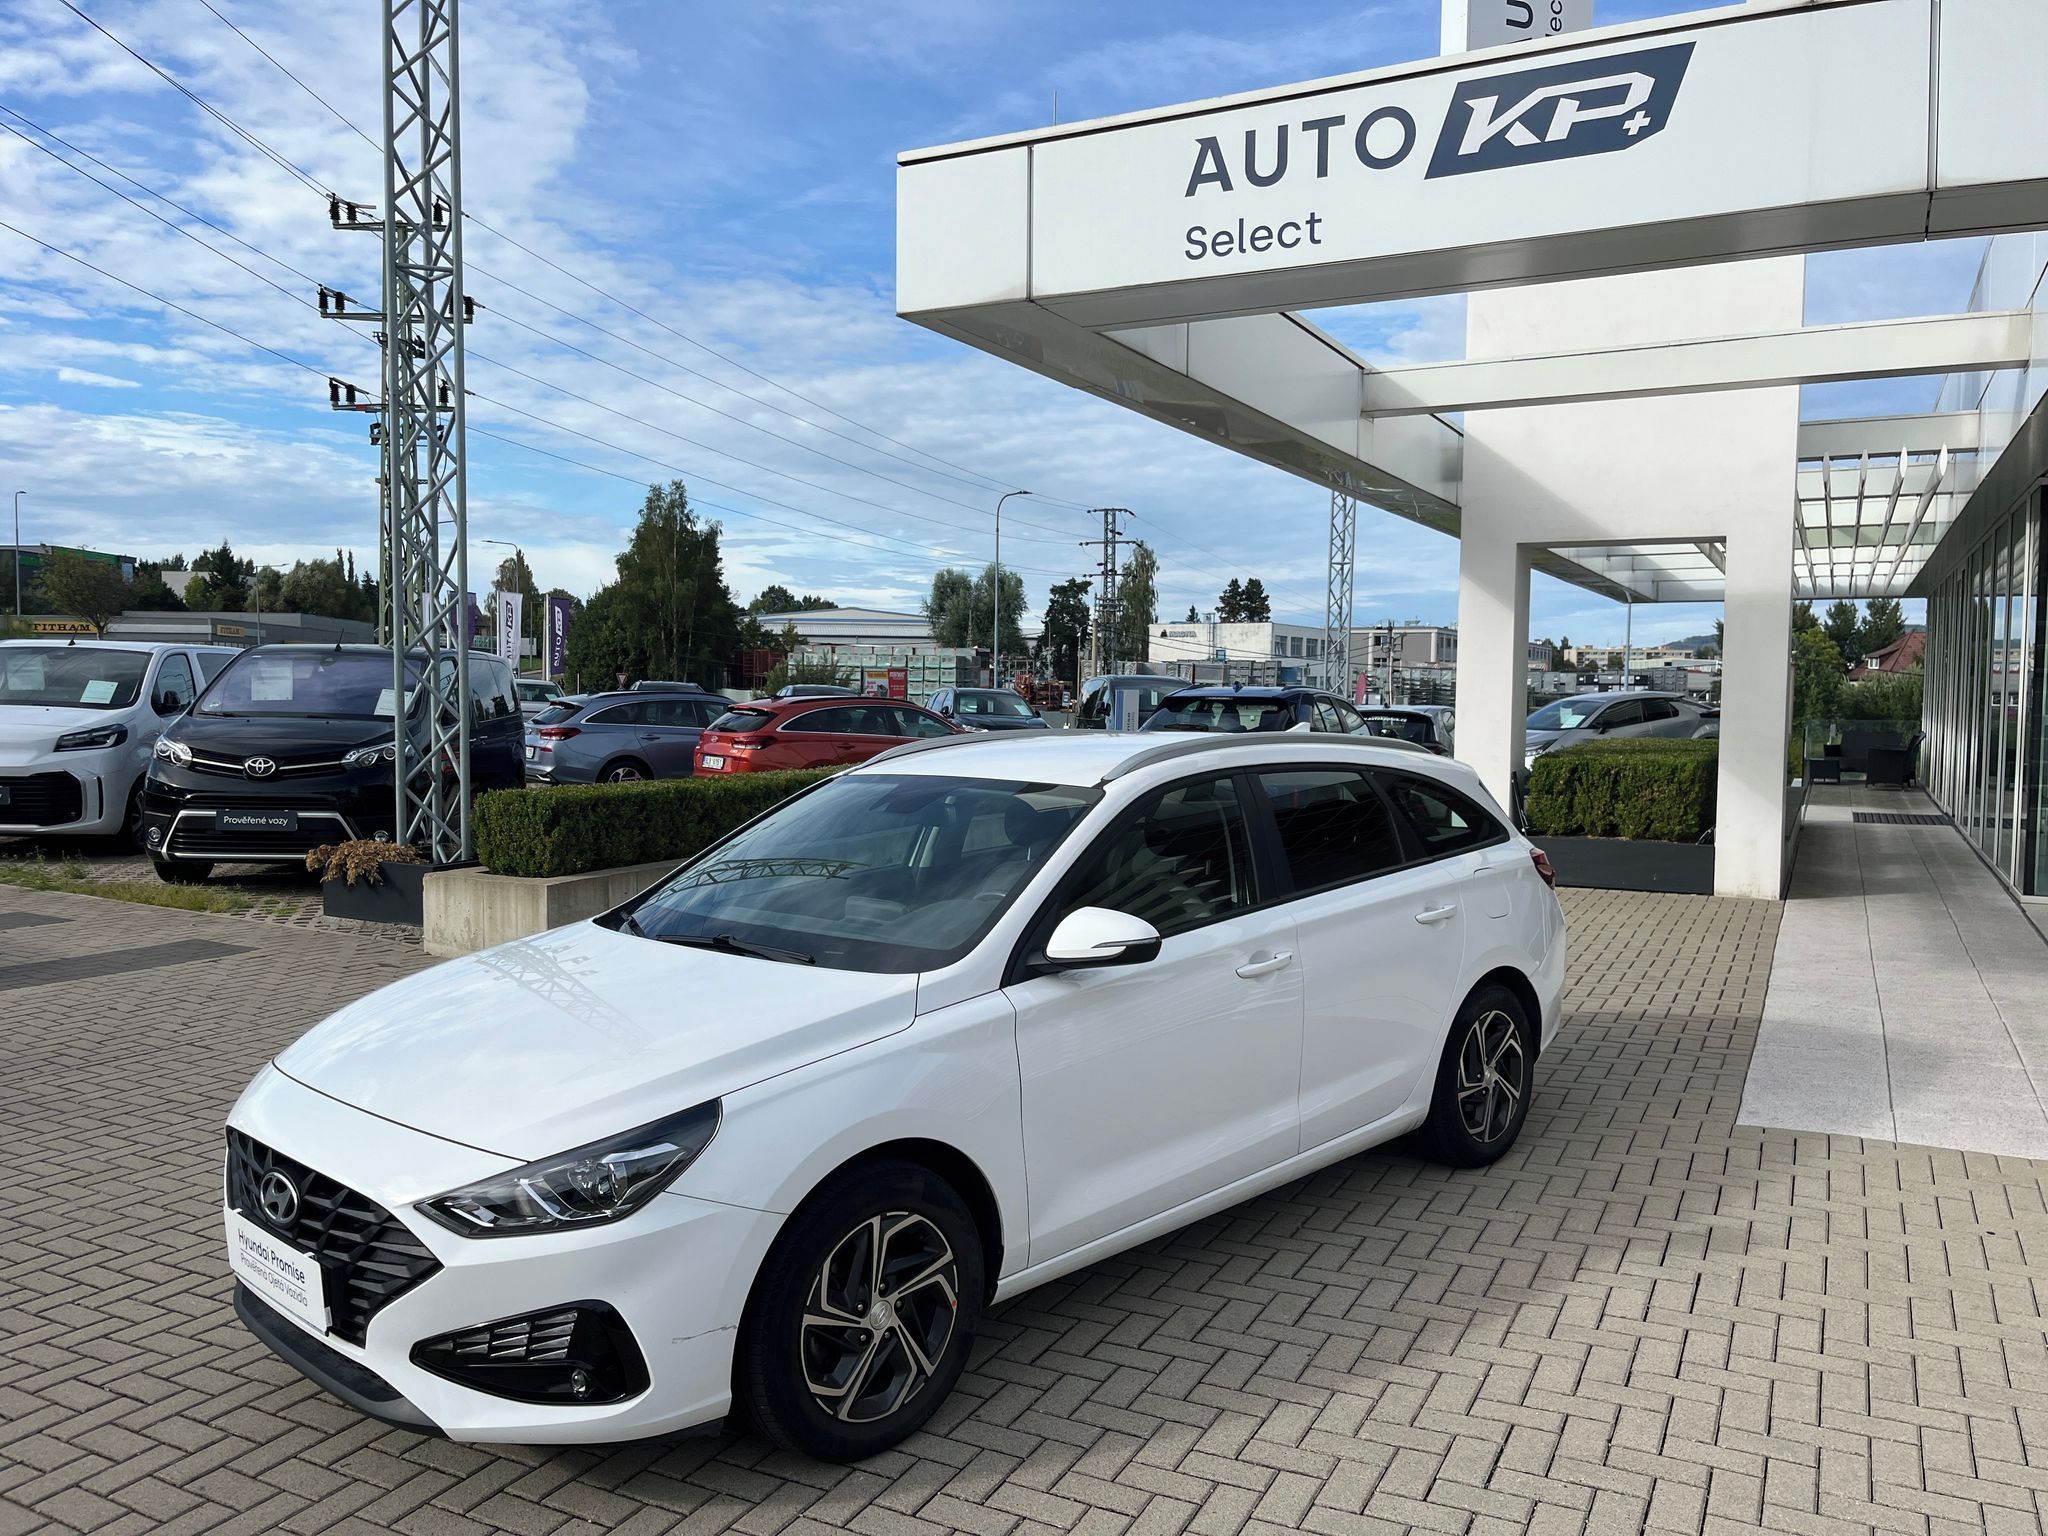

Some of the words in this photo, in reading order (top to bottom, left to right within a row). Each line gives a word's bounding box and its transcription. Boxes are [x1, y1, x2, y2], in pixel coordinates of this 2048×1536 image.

[1185, 106, 1417, 198] AUTO
[1185, 212, 1323, 261] Select
[34, 623, 91, 632] FITHAM
[224, 815, 267, 825] Prověřené
[268, 818, 288, 827] vozy
[238, 1228, 270, 1261] Hyundai
[271, 1250, 305, 1284] Promise
[284, 1284, 308, 1307] Vozidla
